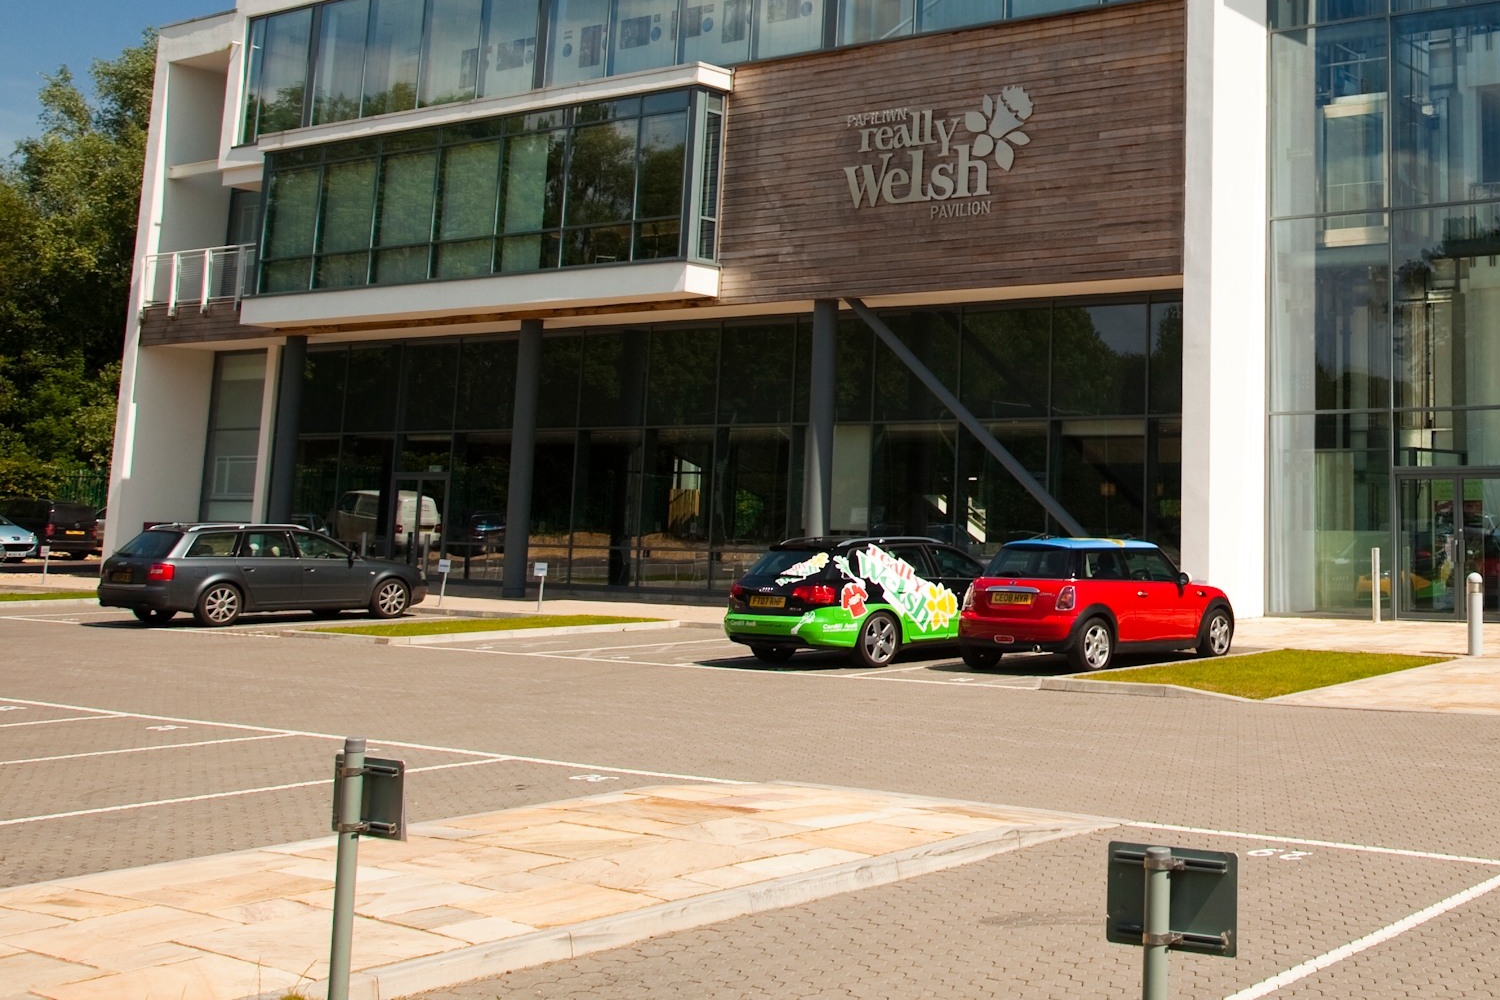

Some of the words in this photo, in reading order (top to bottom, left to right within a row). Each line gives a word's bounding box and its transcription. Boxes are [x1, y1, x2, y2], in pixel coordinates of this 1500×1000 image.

[847, 107, 908, 128] PAFILIWN
[858, 109, 961, 157] really
[843, 144, 990, 210] Welsh
[930, 201, 991, 219] PAVILION
[871, 547, 927, 593] really
[752, 596, 769, 606] FT07
[769, 596, 783, 606] RHF
[858, 554, 930, 627] Welsh
[994, 593, 1013, 602] CE08
[1014, 593, 1029, 602] HYR
